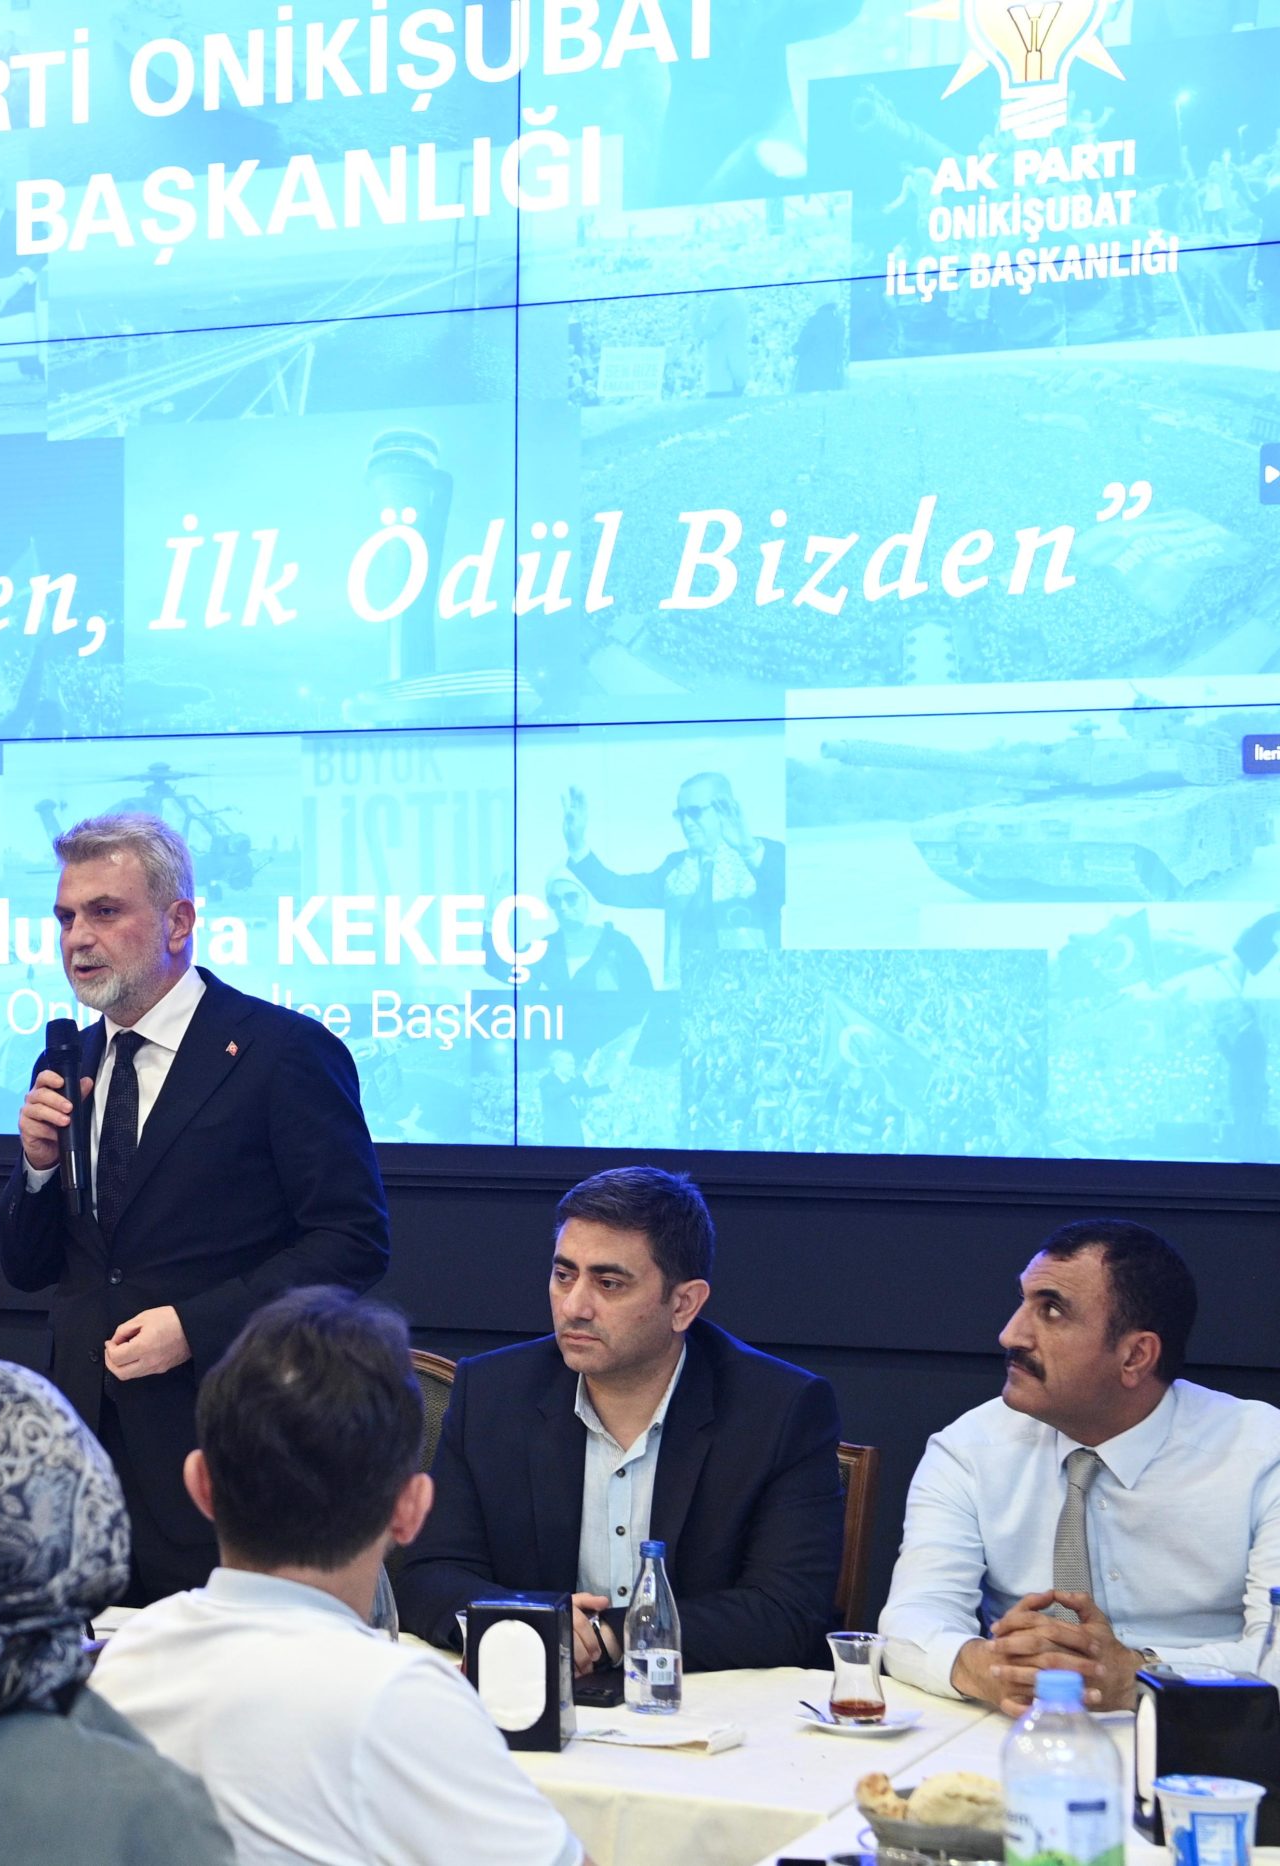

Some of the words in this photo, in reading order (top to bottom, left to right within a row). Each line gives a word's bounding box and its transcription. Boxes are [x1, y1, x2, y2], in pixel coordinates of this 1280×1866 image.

[16, 106, 601, 265] BAŞKANLIĞI
[931, 153, 997, 195] AK
[928, 189, 1137, 243] ONİKİŞUBAT
[886, 253, 958, 302] İLÇE
[969, 230, 1179, 295] BAŞKANLIĞI
[149, 514, 299, 630] İlk
[347, 507, 622, 622] Ödül
[277, 895, 549, 983] KEKEÇ
[372, 990, 563, 1050] Başkanı
